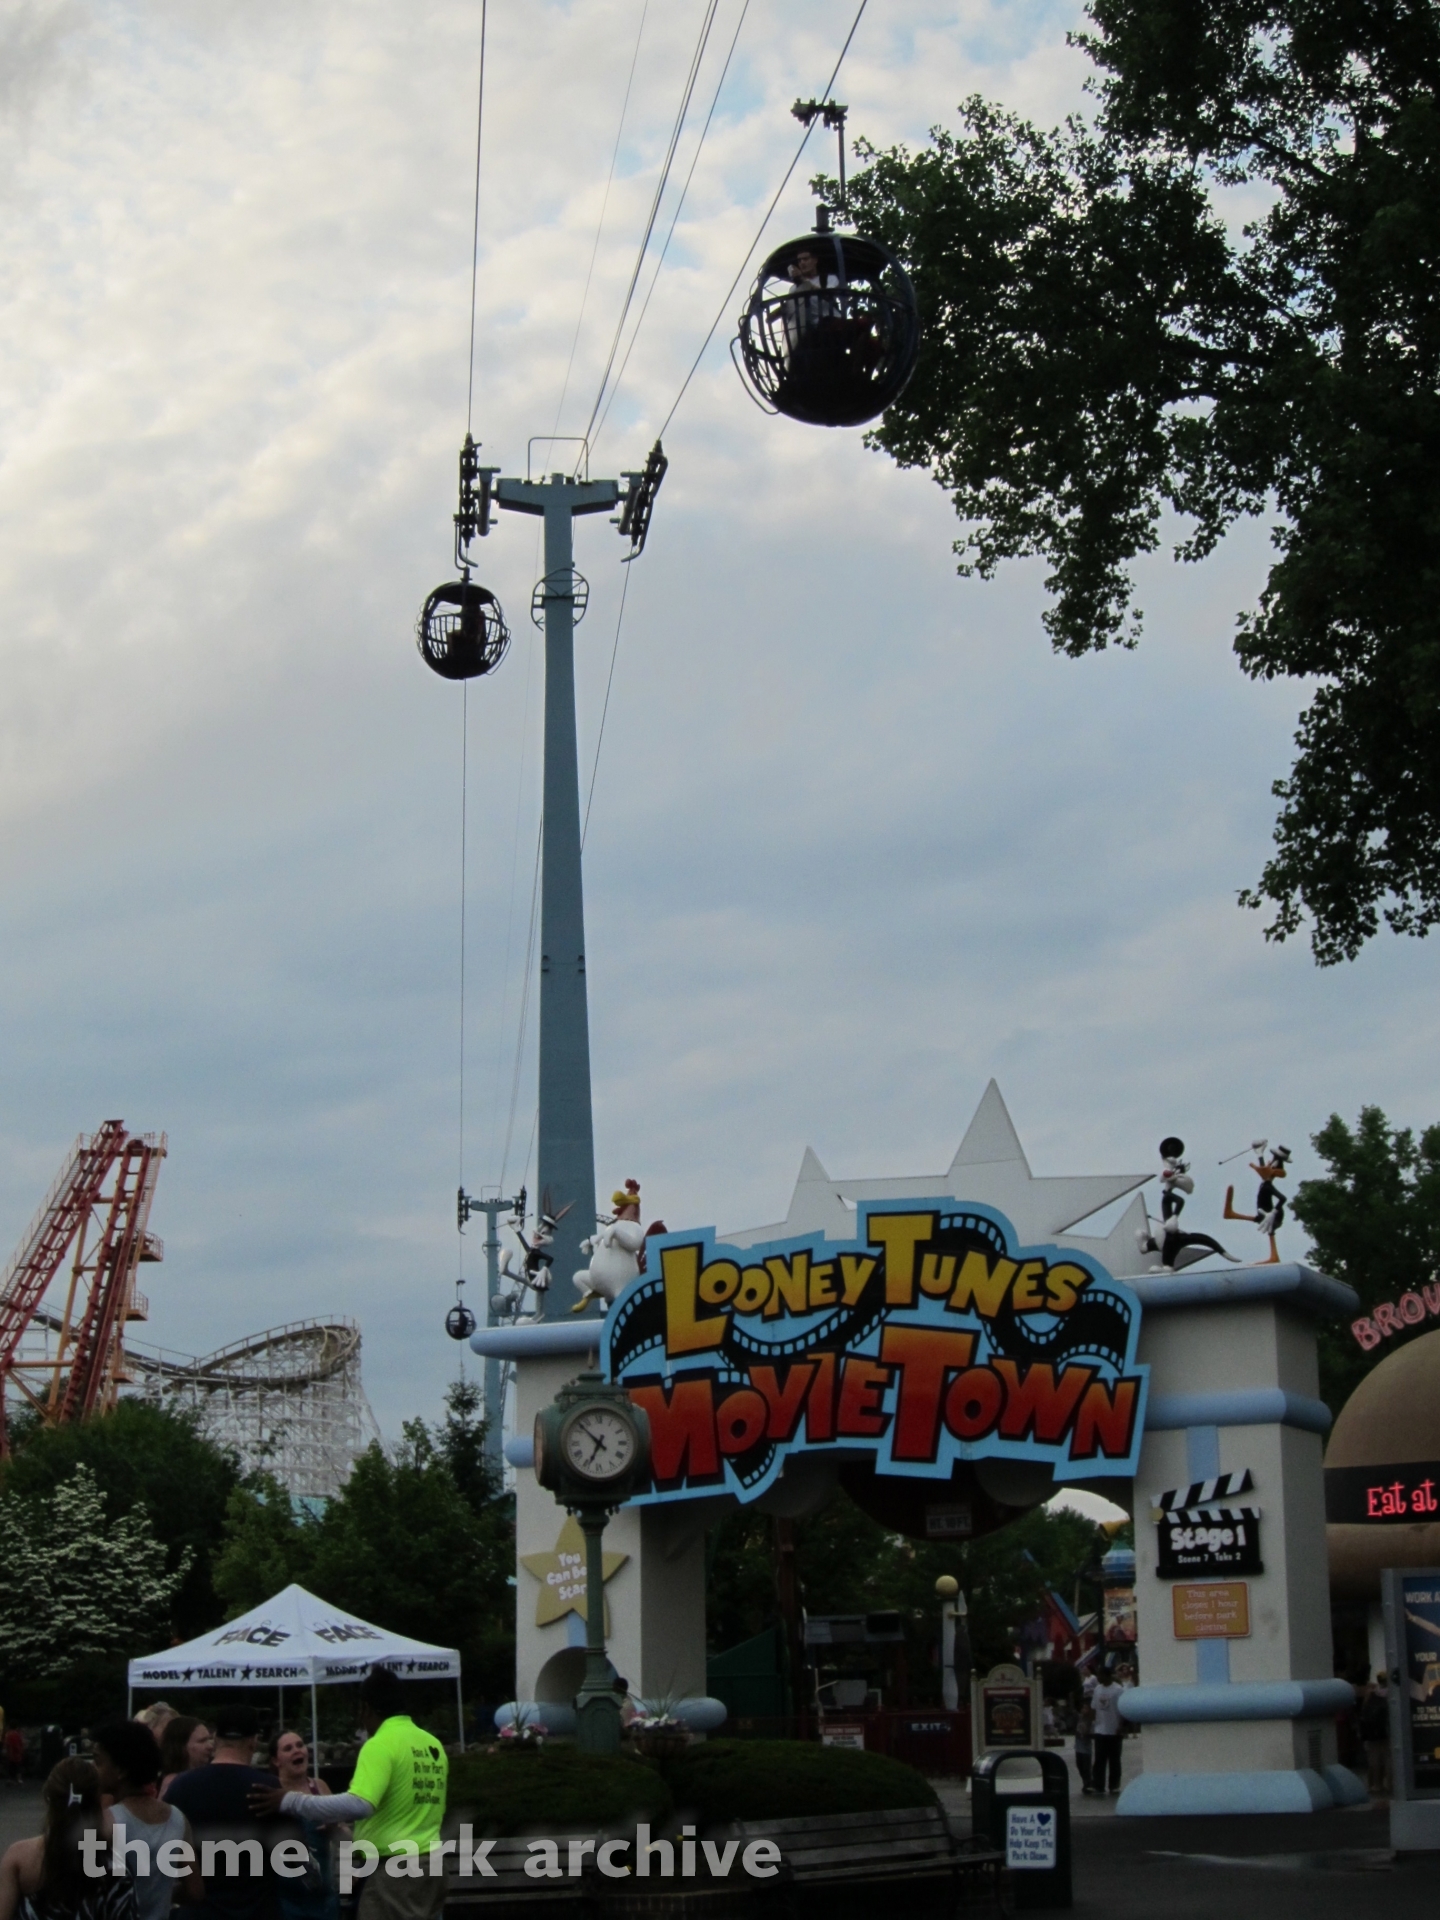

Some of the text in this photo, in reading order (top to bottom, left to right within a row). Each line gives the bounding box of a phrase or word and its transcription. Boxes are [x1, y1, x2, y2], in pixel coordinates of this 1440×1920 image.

[628, 1351, 892, 1482] MOVIE
[880, 1324, 1139, 1463] TOWN
[1366, 1479, 1439, 1516] Eat at
[1170, 1525, 1247, 1552] Stage 1
[557, 1552, 582, 1567] You
[1177, 1552, 1242, 1564] Scene 7 Take 2
[546, 1570, 571, 1586] Can
[558, 1583, 588, 1601] Star
[1186, 1589, 1230, 1598] This area
[1405, 1591, 1433, 1604] WORK
[1181, 1600, 1239, 1610] closes 1 hour
[1183, 1610, 1238, 1621] before park
[312, 1623, 385, 1644] FACE
[1194, 1622, 1228, 1633] closing
[211, 1626, 292, 1648] FACE
[1414, 1652, 1438, 1663] YOUR
[417, 1661, 450, 1672] SEARCH
[142, 1667, 298, 1681] MODEL TALENT SEARCH
[911, 1722, 942, 1731] EXIT
[1011, 1813, 1036, 1824] Have A
[1010, 1826, 1019, 1836] Do
[1020, 1826, 1036, 1836] Your
[1009, 1838, 1054, 1850] Help Keep The
[1012, 1850, 1028, 1861] Park
